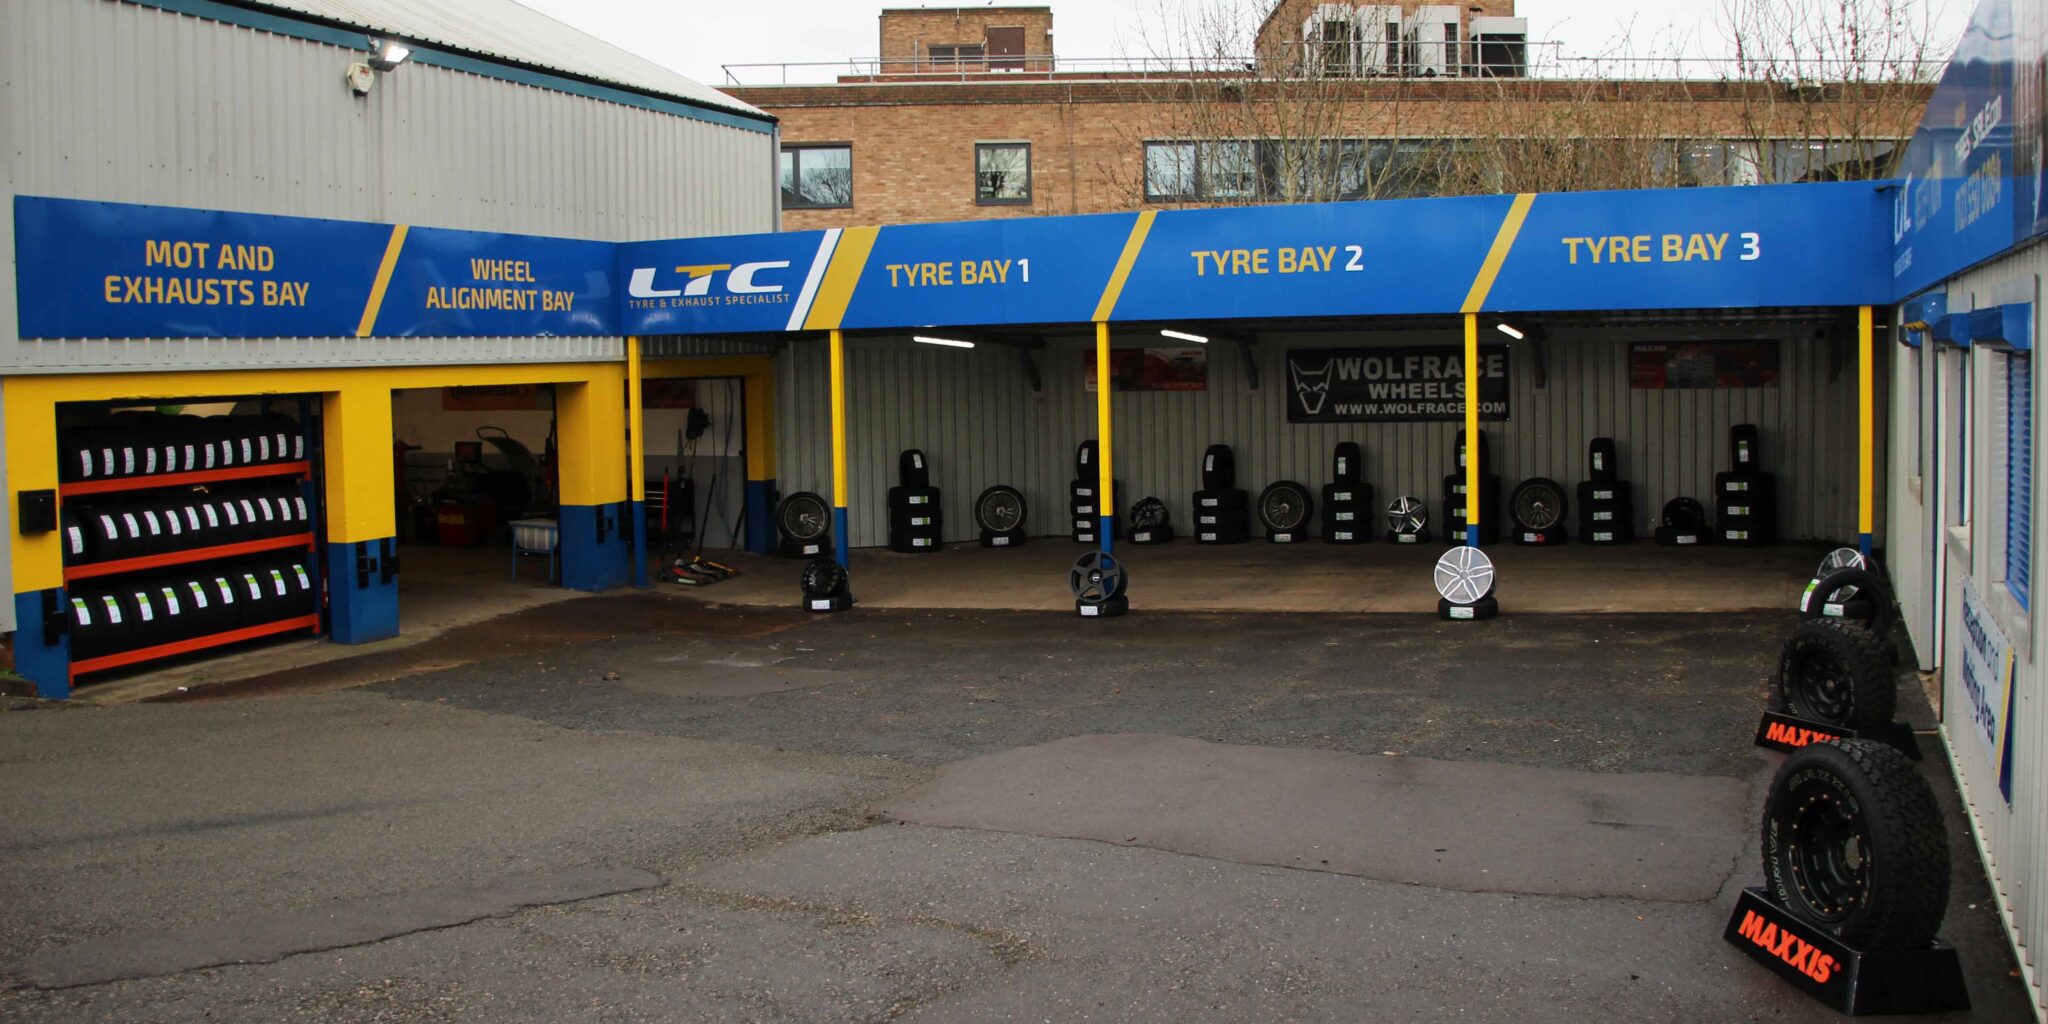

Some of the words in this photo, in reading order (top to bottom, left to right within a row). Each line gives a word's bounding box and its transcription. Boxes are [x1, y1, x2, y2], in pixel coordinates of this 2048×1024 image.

[146, 240, 210, 269] MOT
[217, 244, 274, 271] AND
[1191, 249, 1269, 276] TYRE
[1278, 246, 1337, 273] BAY
[1345, 245, 1364, 271] 2
[1562, 235, 1651, 264] TYRE
[1662, 233, 1730, 262] BAY
[1740, 232, 1761, 261] 3
[471, 258, 535, 282] WHEEL
[628, 260, 790, 298] LTC
[886, 262, 953, 288] TYRE
[961, 259, 1011, 284] BAY
[1018, 258, 1029, 282] 1
[104, 275, 255, 305] EXHAUSTS
[263, 280, 310, 306] BAY
[426, 286, 538, 310] ALIGNMENT
[542, 290, 575, 311] BAY
[628, 299, 655, 309] TYRE
[659, 298, 668, 308] &
[671, 296, 721, 307] EXHAUST
[725, 293, 790, 305] SPECIALIST
[1368, 382, 1467, 399] WHEELS
[1334, 401, 1507, 414] WWW.WOLFRACEOM
[1738, 909, 1835, 983] MAXXIS
